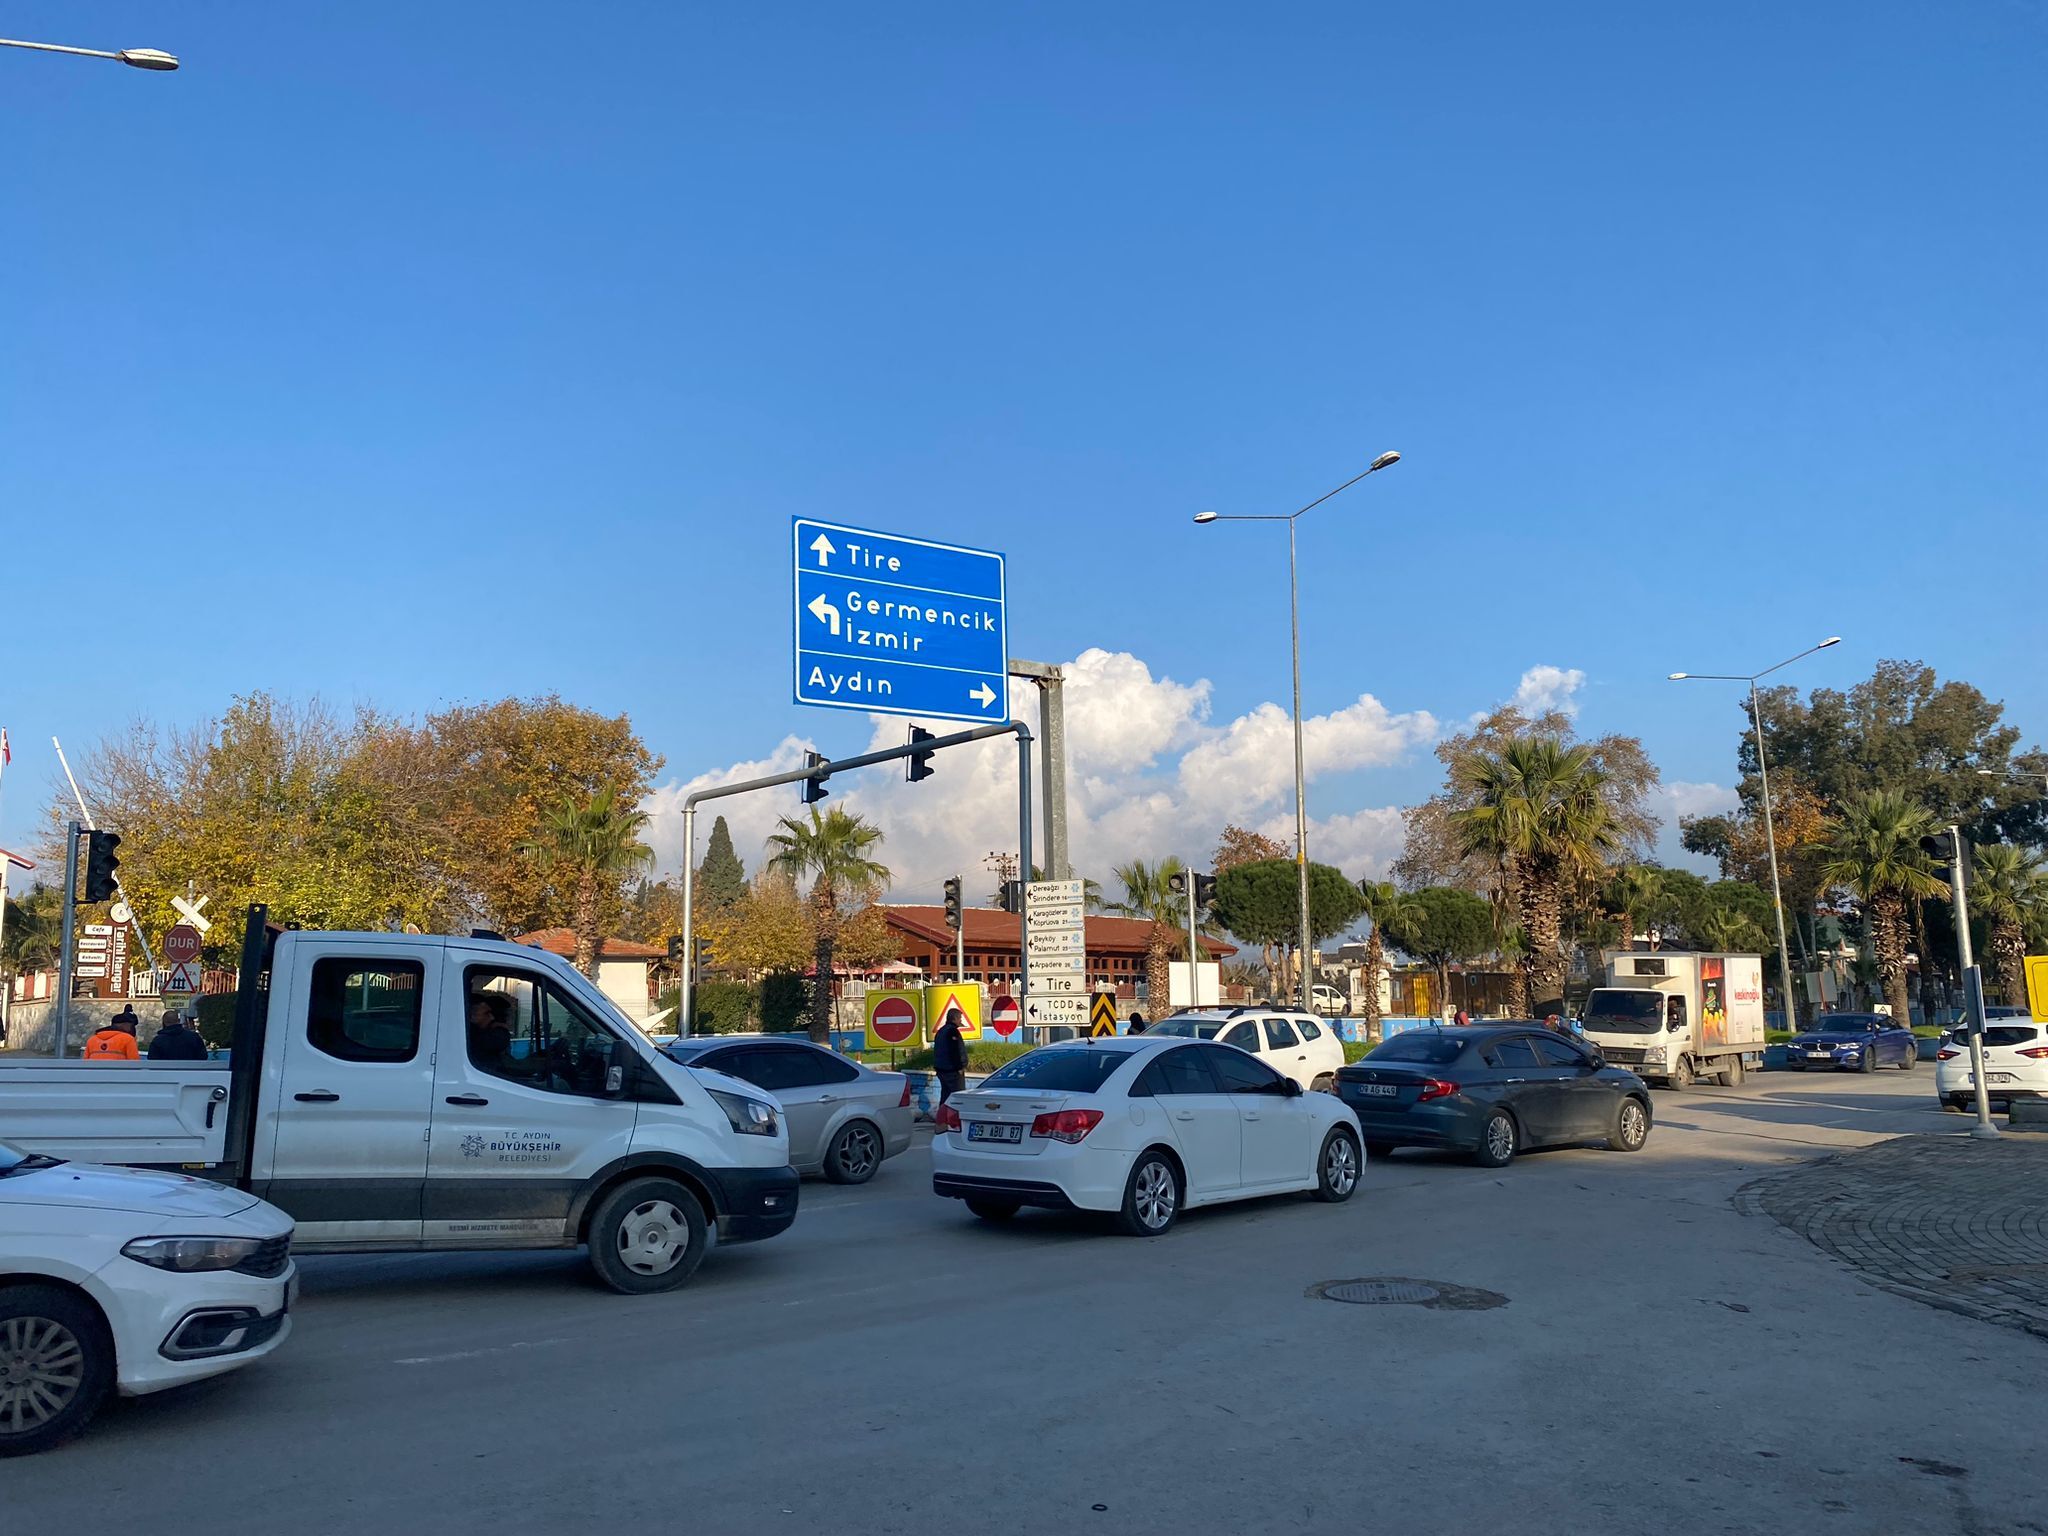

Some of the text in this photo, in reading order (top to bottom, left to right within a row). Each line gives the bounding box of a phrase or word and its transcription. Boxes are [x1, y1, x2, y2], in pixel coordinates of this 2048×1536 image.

[846, 544, 902, 572] Tire
[846, 591, 996, 632] Germencik
[846, 617, 924, 652] İzmir
[808, 666, 893, 695] Aydın
[169, 937, 194, 949] DUR
[1035, 961, 1062, 970] Arpadere
[112, 956, 125, 993] Hangar
[1046, 978, 1072, 990] Tire
[1047, 1000, 1074, 1009] TCDD
[1039, 1010, 1083, 1023] İstasyon
[490, 1141, 561, 1153] BÜYÜKŞEHİR
[498, 1154, 551, 1162] BELEDİYESİ
